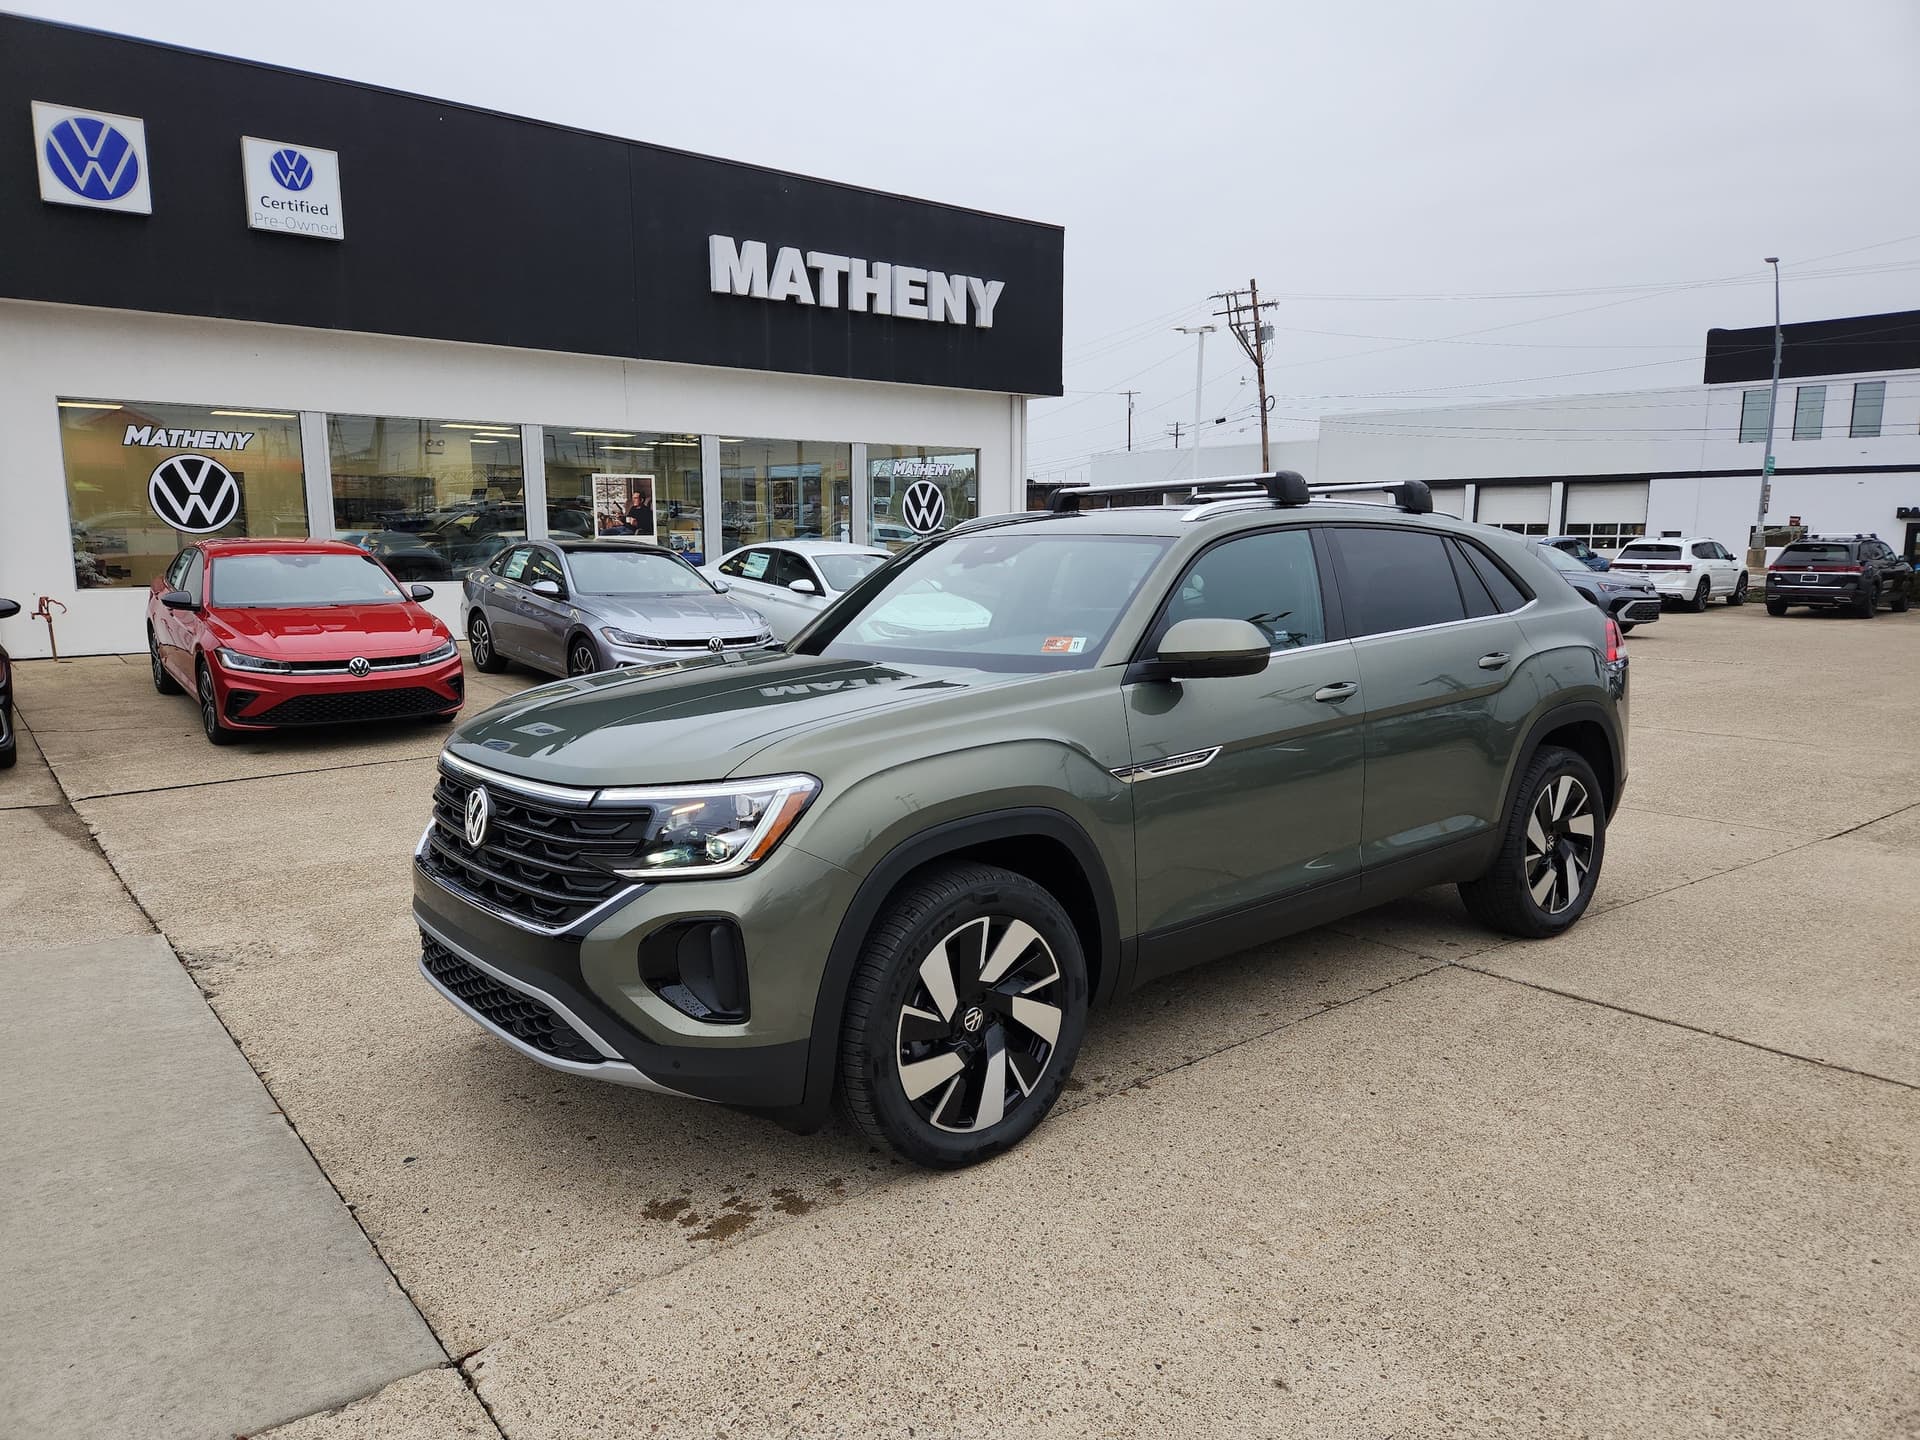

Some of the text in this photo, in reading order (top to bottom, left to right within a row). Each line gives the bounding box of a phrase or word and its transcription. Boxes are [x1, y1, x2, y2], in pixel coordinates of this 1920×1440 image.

[260, 195, 329, 216] Certified
[254, 212, 338, 235] Pre-Owned
[708, 233, 1006, 329] MATHENY
[122, 424, 254, 450] MATHENY
[892, 459, 954, 477] MATHENY
